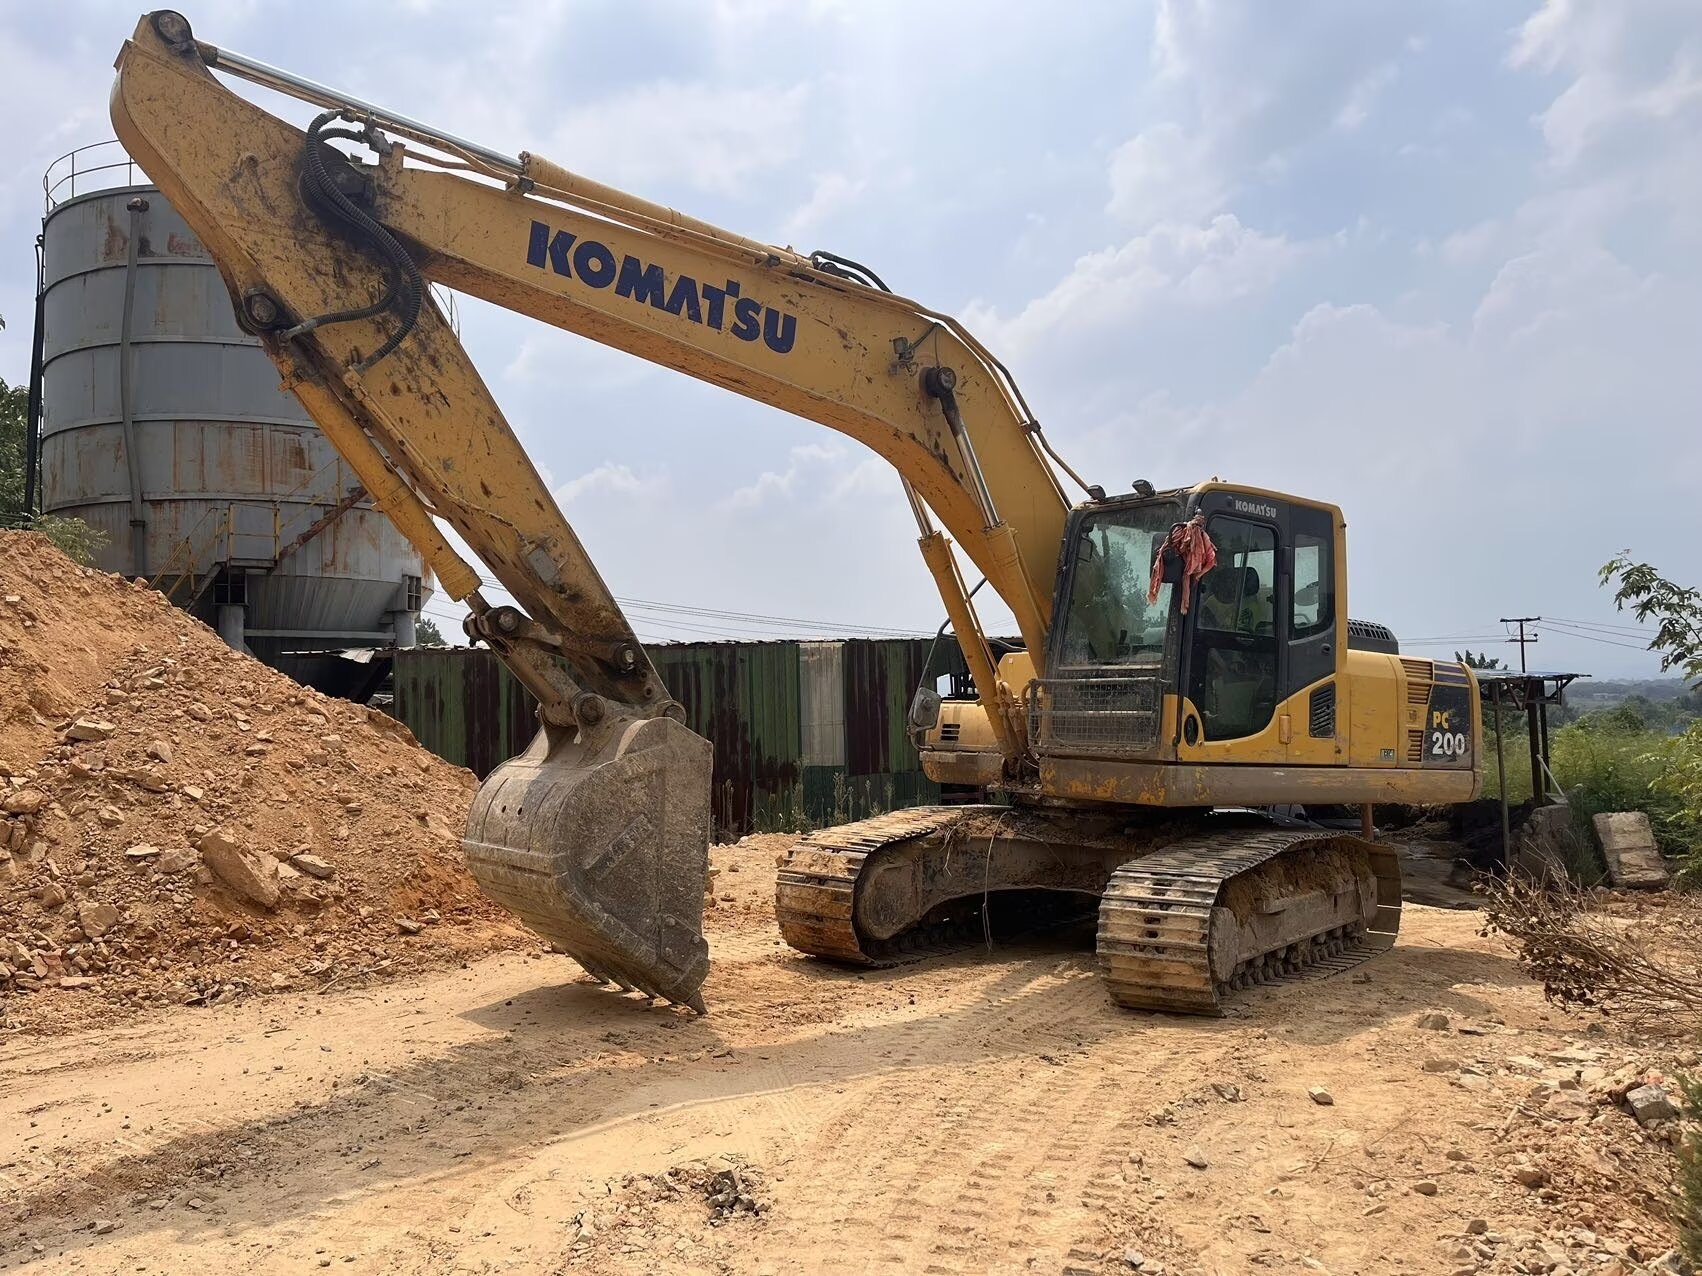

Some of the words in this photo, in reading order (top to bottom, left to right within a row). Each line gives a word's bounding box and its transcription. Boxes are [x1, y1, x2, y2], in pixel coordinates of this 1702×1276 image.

[527, 220, 797, 354] KOMATSU
[1235, 500, 1276, 518] KOMATSU
[1433, 711, 1448, 729] PC
[1432, 732, 1465, 755] 200
